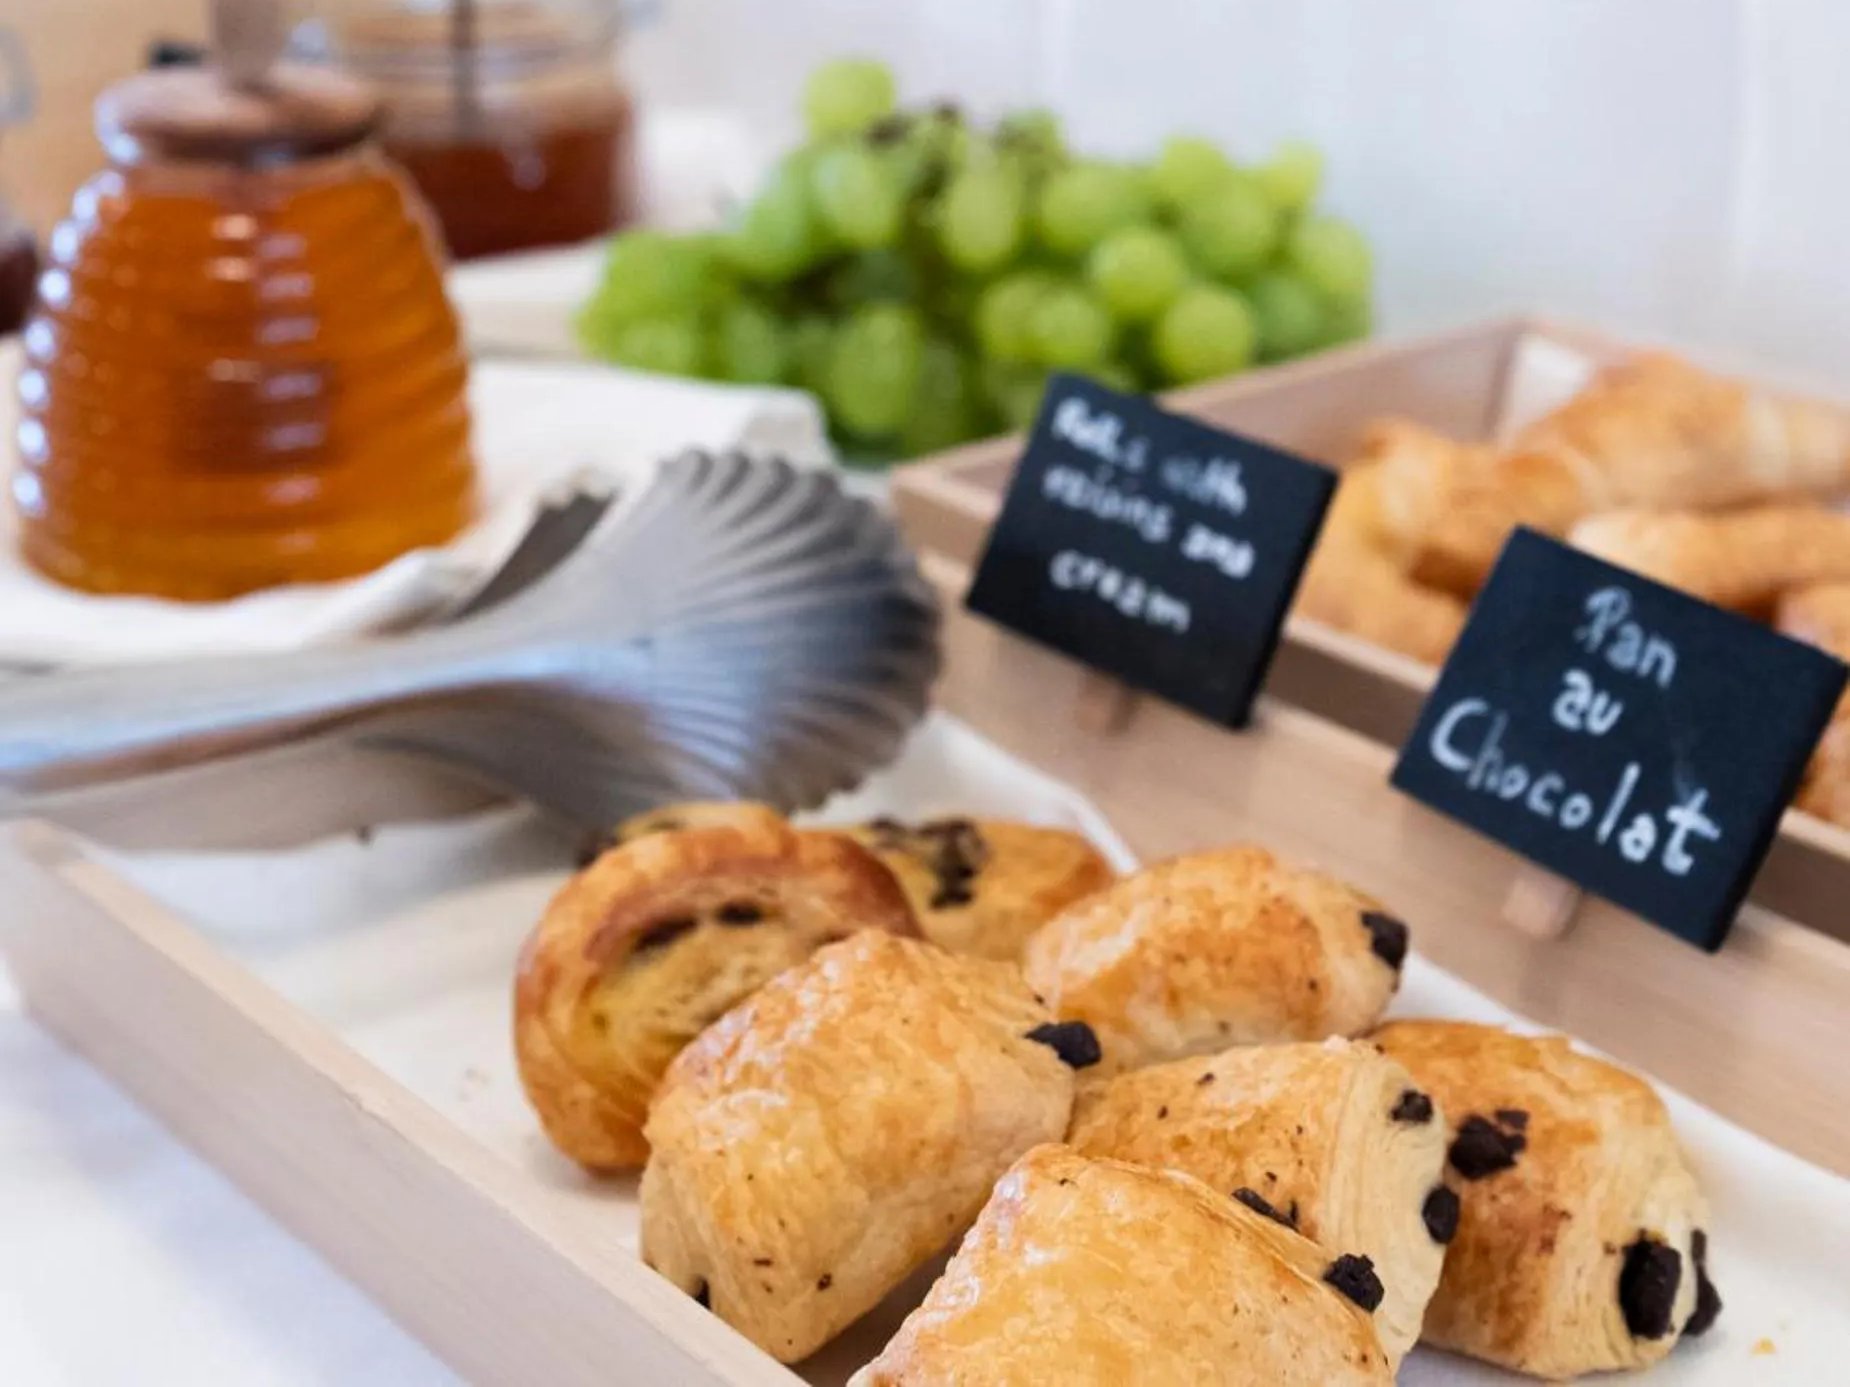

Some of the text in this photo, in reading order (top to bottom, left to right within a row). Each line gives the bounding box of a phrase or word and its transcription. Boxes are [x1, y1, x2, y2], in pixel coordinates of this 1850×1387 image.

[1049, 548, 1191, 634] cream
[1180, 524, 1256, 579] and
[1574, 586, 1679, 688] Pan
[1551, 668, 1625, 734] au
[1429, 696, 1721, 875] Chocolat
